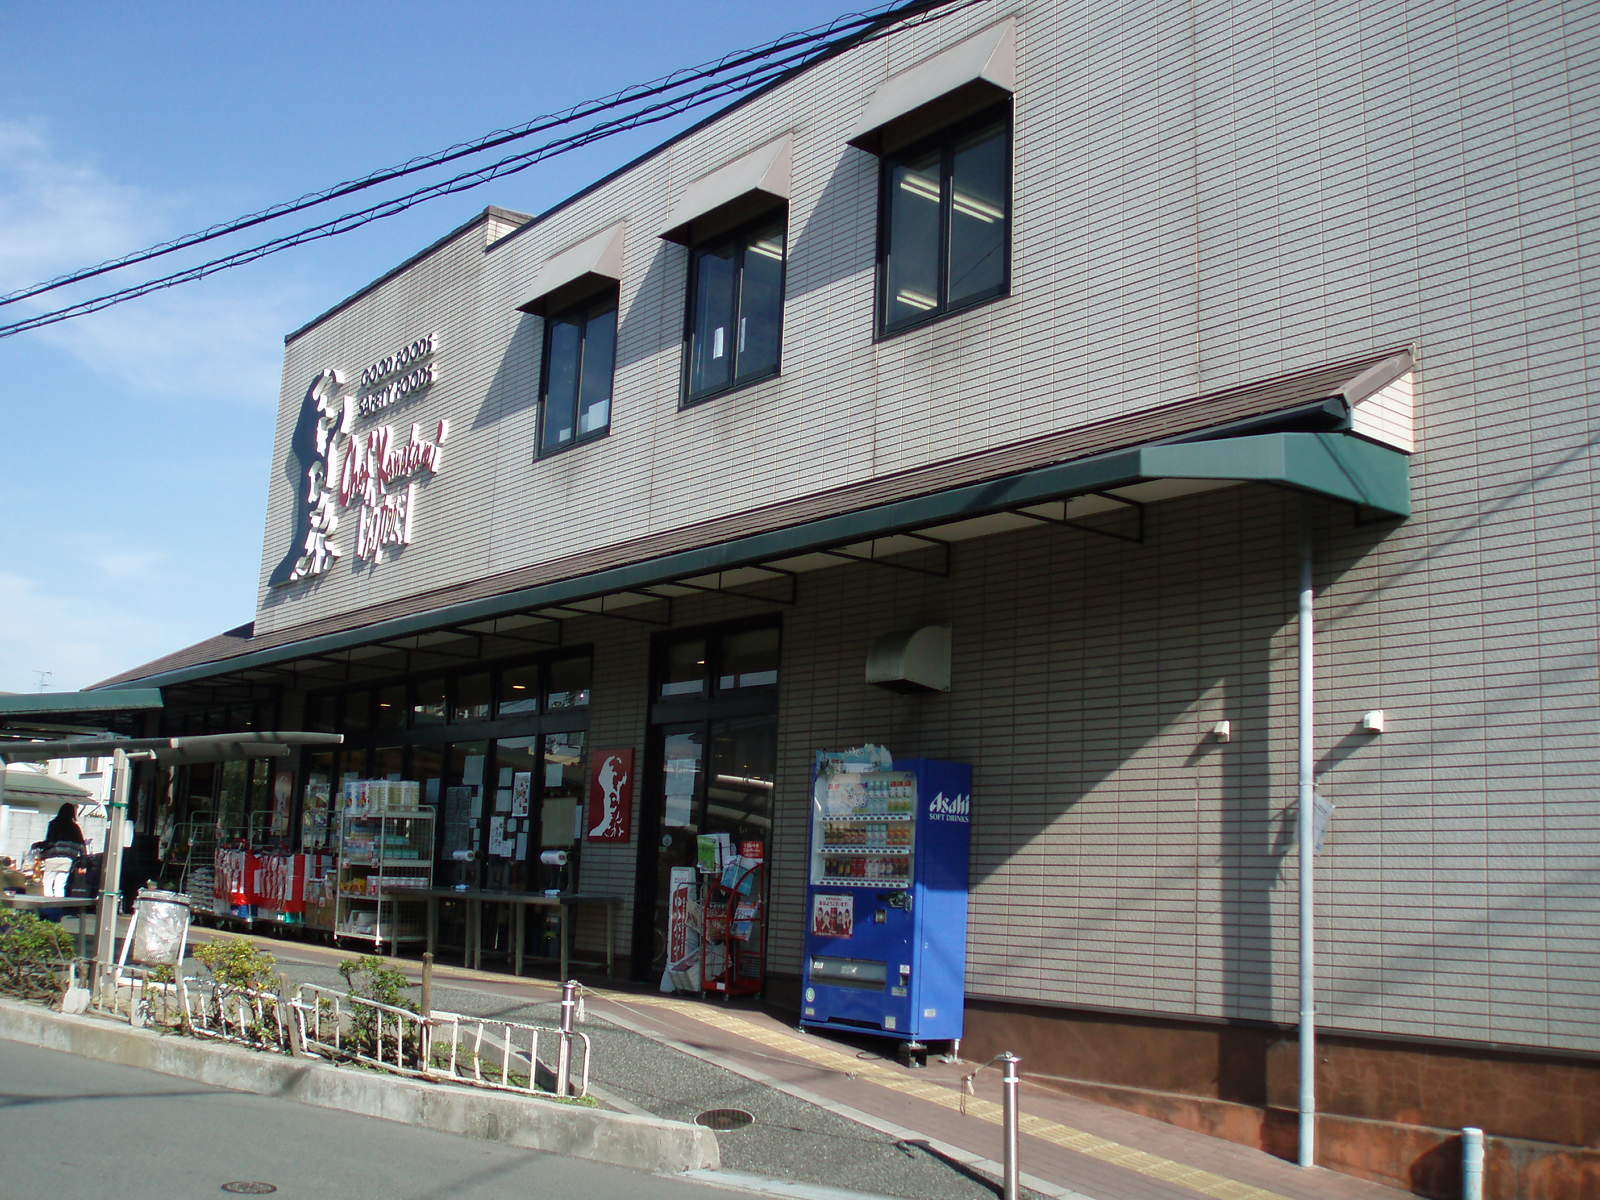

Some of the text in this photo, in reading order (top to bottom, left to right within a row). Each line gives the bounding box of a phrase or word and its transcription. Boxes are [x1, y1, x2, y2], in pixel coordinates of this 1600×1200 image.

[361, 333, 435, 386] GOOD FOODS
[358, 362, 436, 417] SAFETY FOODS
[340, 419, 449, 506] Chef Kawakami
[929, 791, 970, 815] Asahi
[929, 813, 969, 823] SOFT DRINKS
